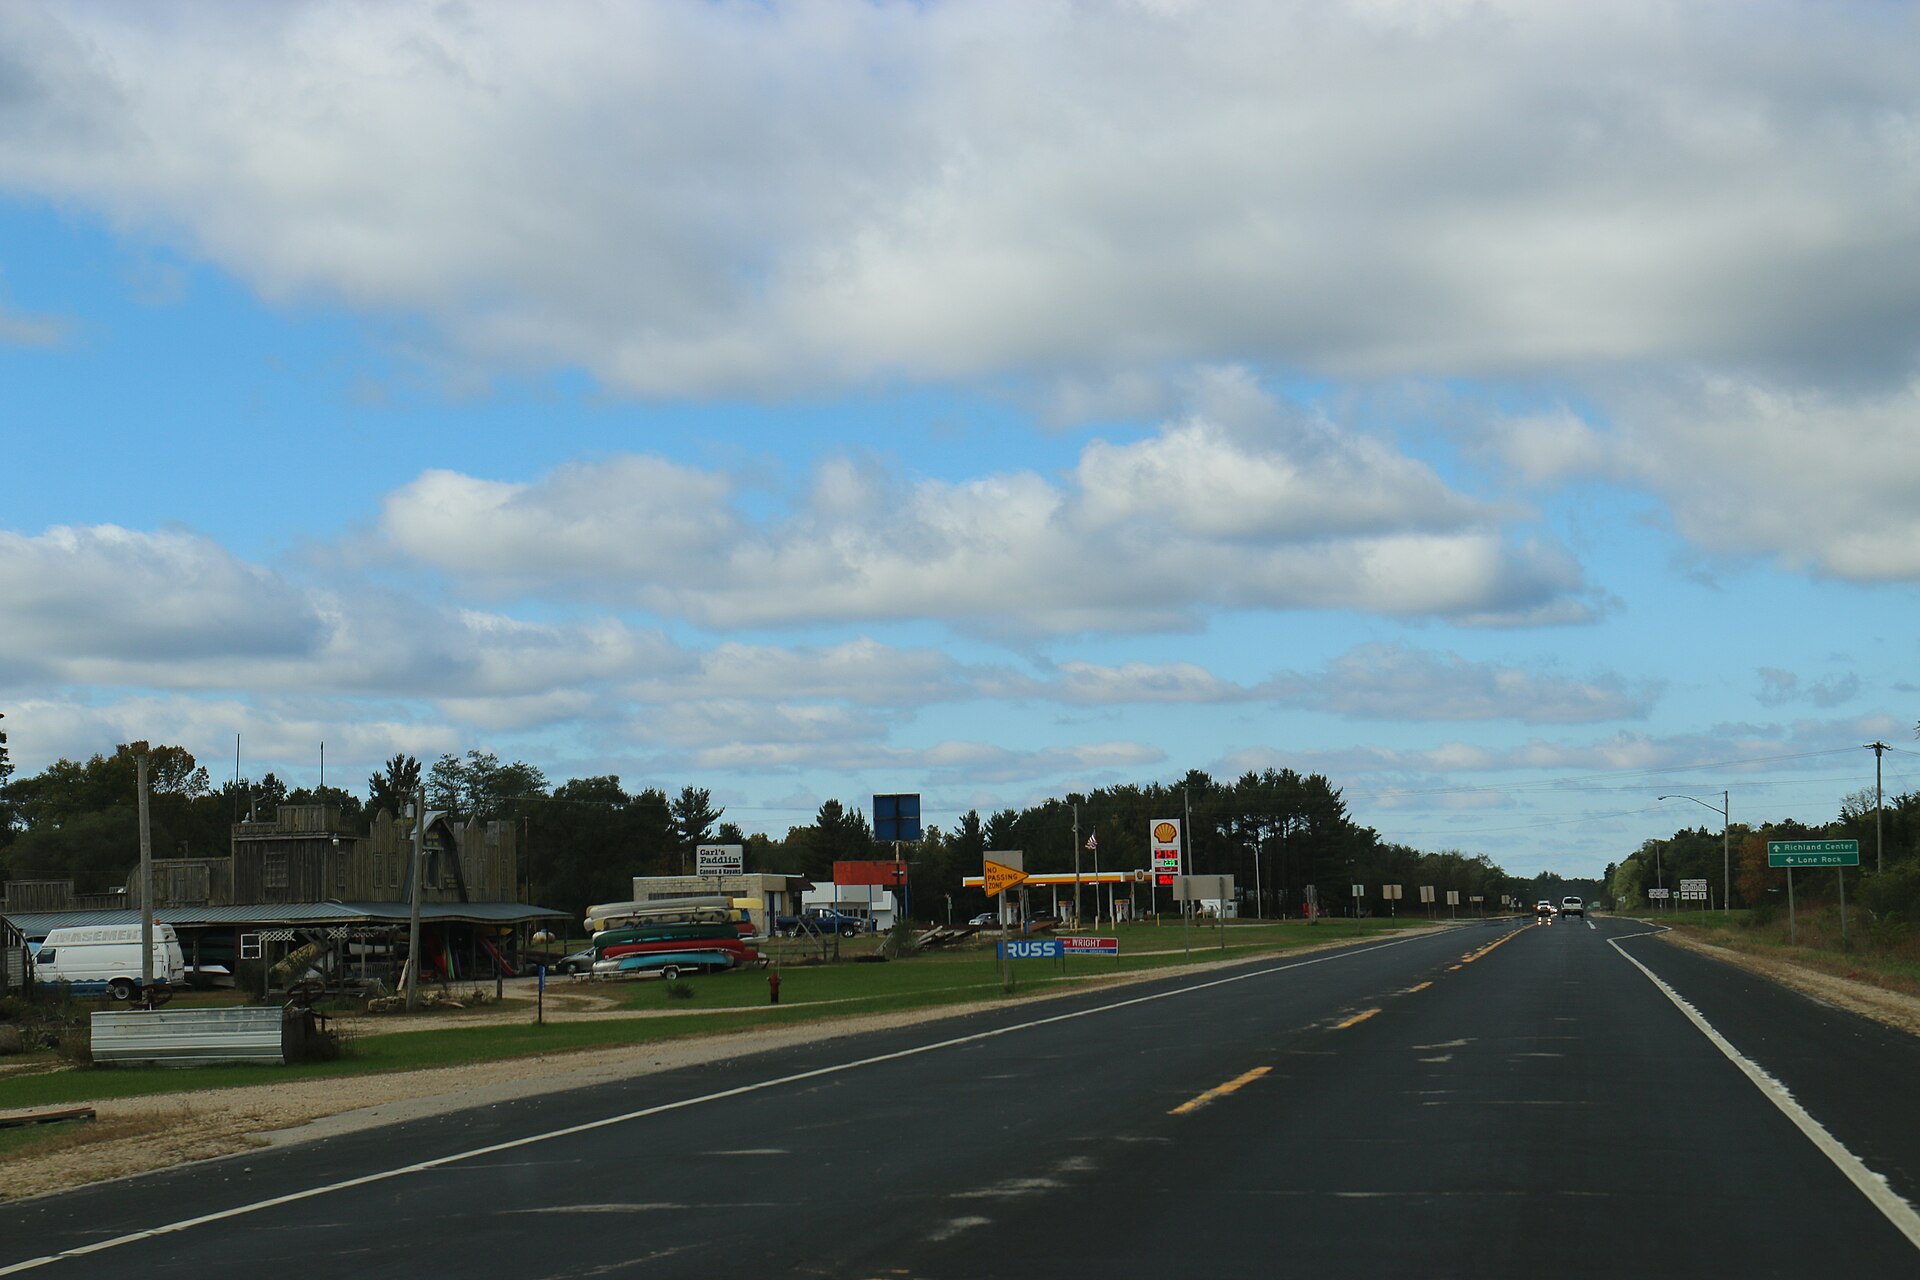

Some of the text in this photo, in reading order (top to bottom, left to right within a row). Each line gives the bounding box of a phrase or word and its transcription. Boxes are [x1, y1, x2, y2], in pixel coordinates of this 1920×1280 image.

[700, 856, 741, 864] Paddlin'
[988, 873, 1017, 881] PASSING
[1072, 939, 1101, 947] WRIGHT
[1008, 943, 1056, 957] RUSS
